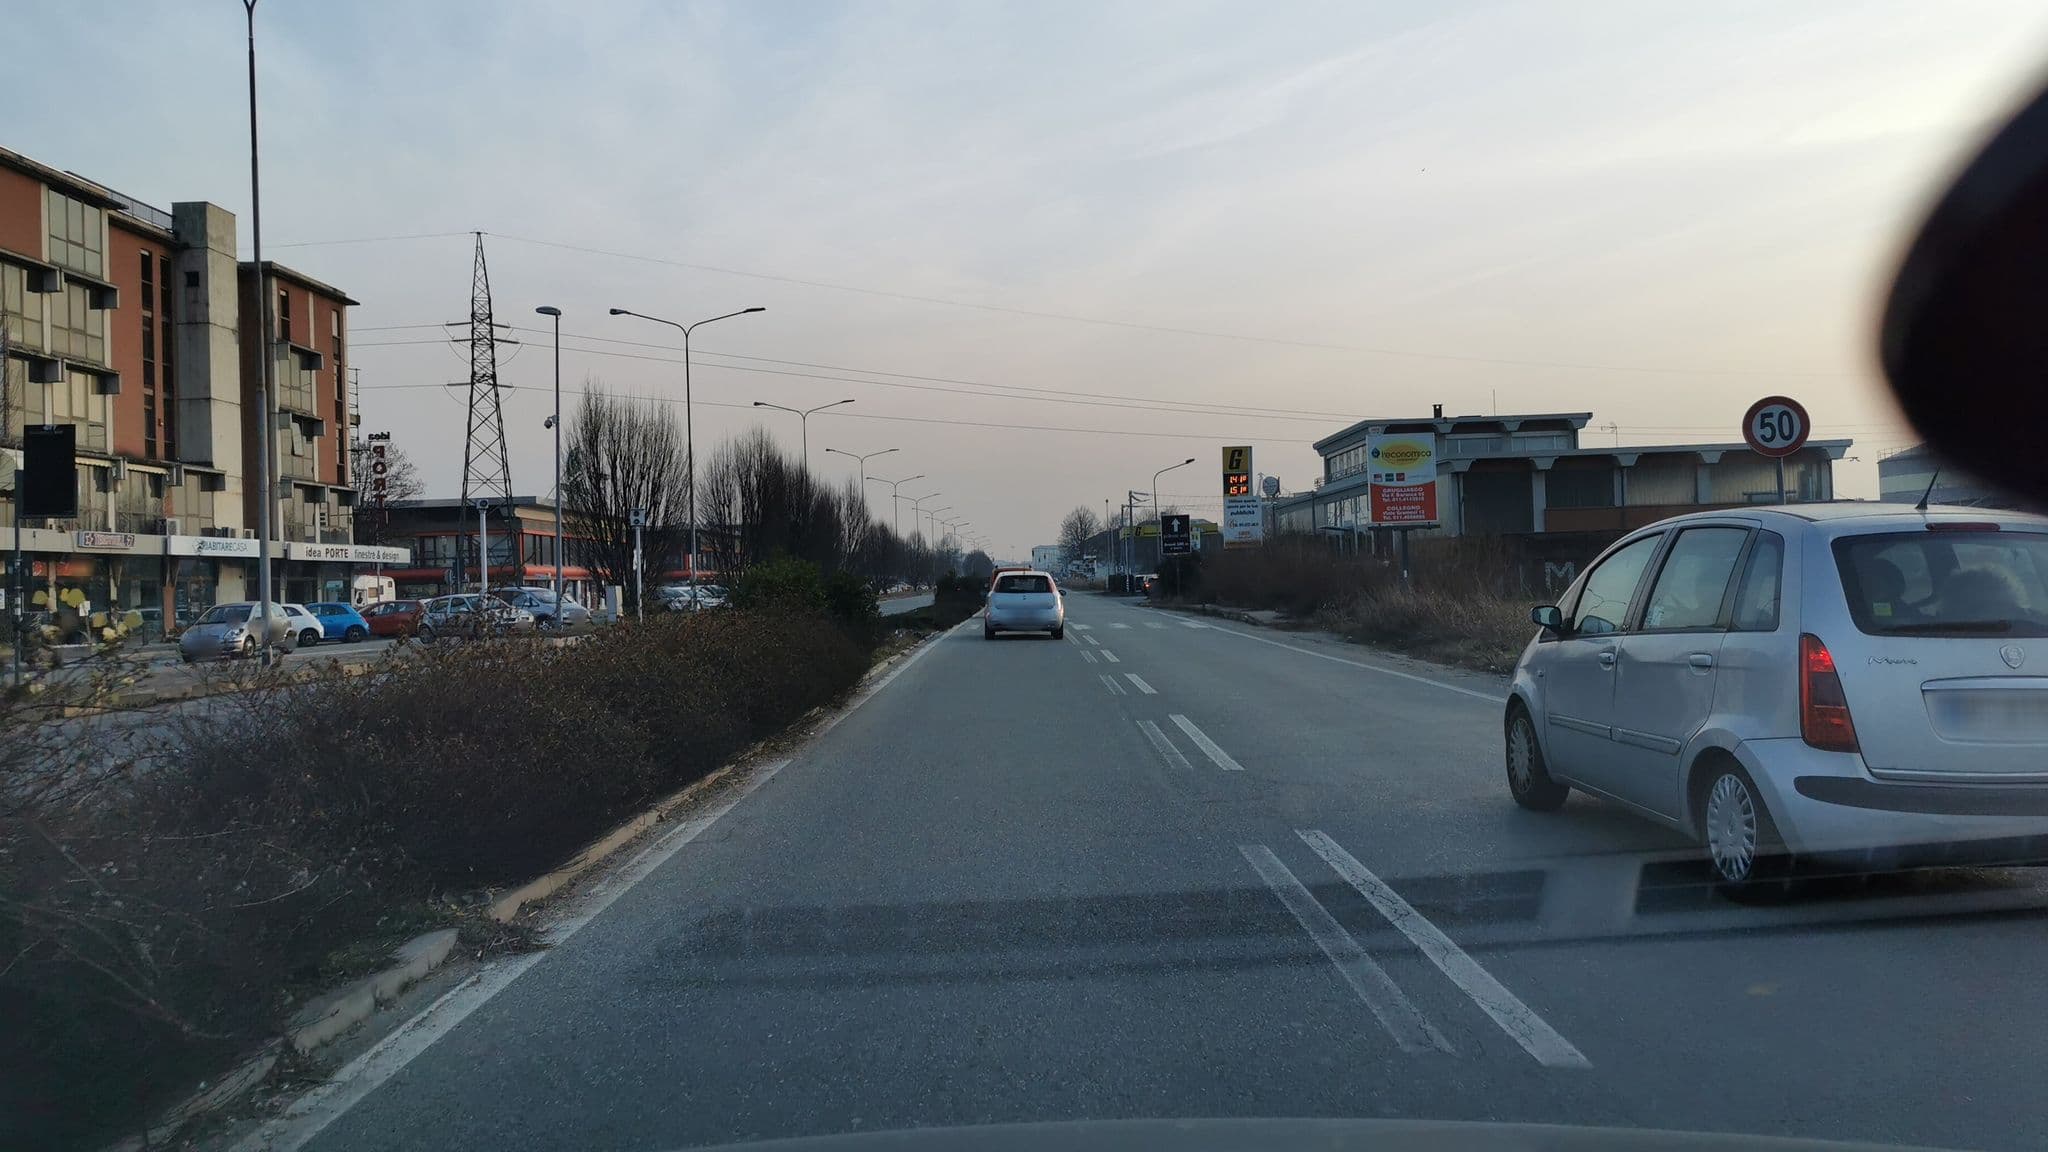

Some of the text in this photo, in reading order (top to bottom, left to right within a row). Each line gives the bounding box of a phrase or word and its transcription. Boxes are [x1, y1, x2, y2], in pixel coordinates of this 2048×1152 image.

[1760, 410, 1794, 443] 50
[1229, 449, 1243, 470] G
[305, 546, 321, 557] idea
[325, 547, 349, 558] PORTE
[376, 551, 380, 560] &
